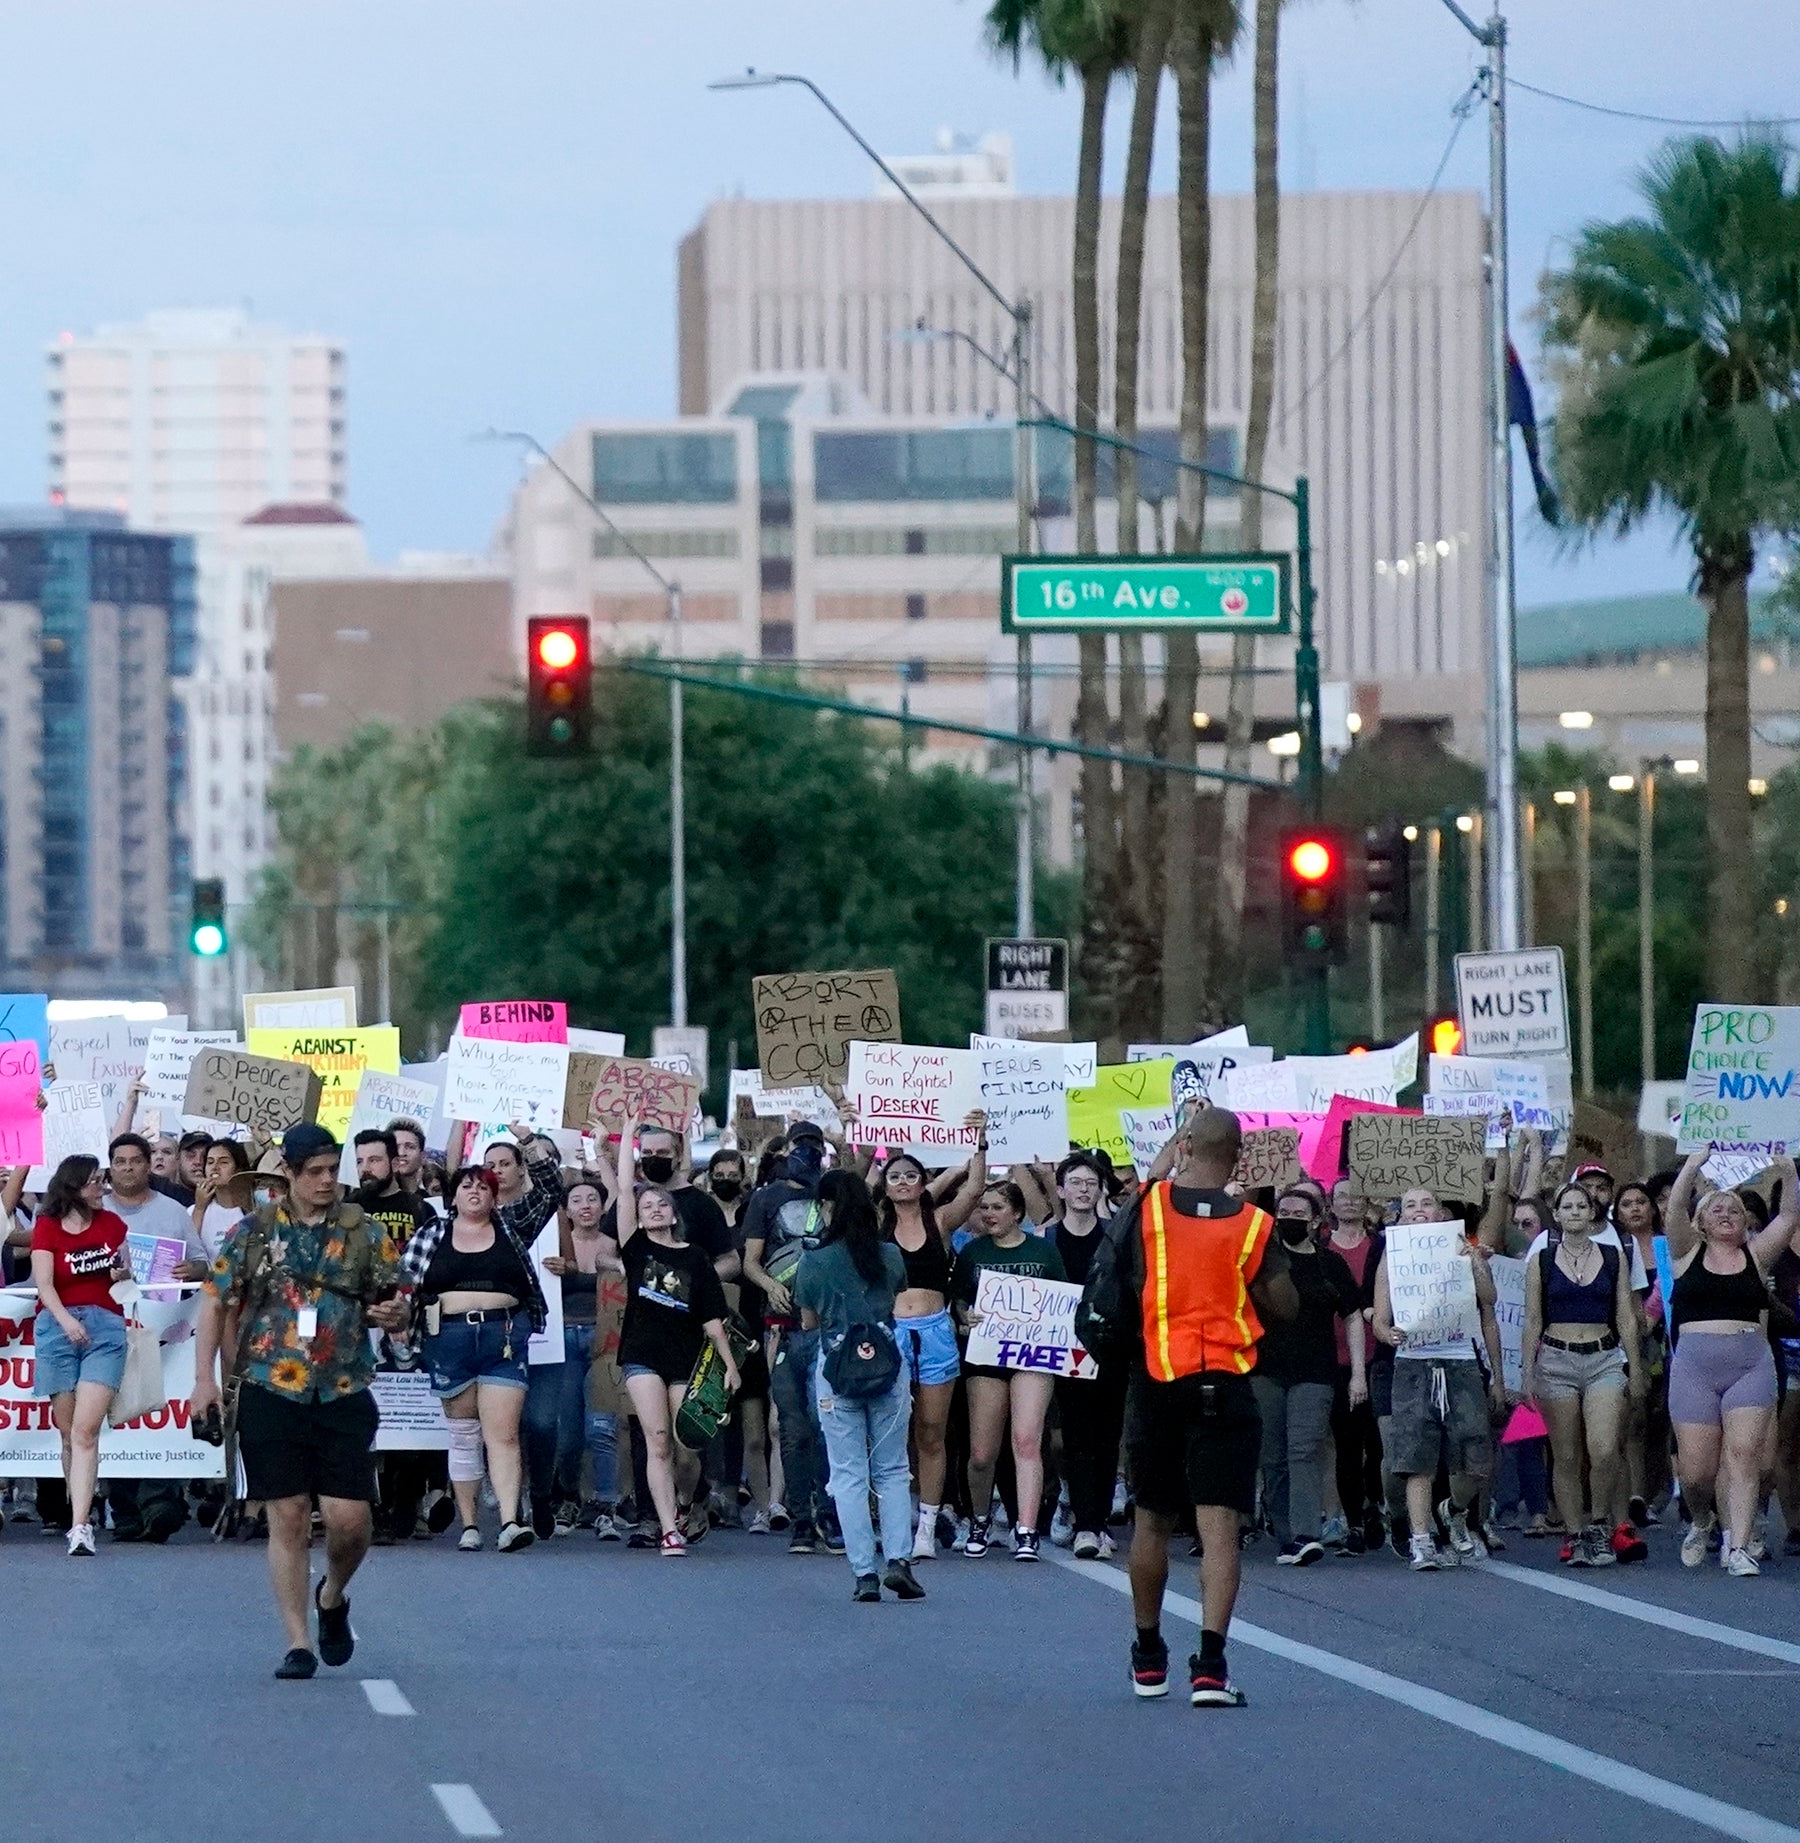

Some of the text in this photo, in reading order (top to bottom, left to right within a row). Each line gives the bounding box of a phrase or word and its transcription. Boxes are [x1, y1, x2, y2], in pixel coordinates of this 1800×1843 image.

[1039, 578, 1191, 609] 16th Ave.
[999, 945, 1053, 967] RIGHT
[1000, 969, 1051, 989] LANE
[1465, 961, 1552, 981] RIGHT LANE
[757, 974, 884, 1005] ABORT
[480, 1002, 555, 1025] BEHIND
[999, 1002, 1054, 1019] BUSES
[1471, 987, 1552, 1019] MUST
[784, 1013, 858, 1039] THE
[1472, 1026, 1559, 1045] TURN RIGHT
[1699, 1010, 1776, 1046] PRO
[48, 1024, 111, 1058] Respect
[170, 1036, 188, 1045] Your
[193, 1036, 232, 1045] Rosaries
[292, 1038, 357, 1055] AGAINST
[457, 1040, 560, 1073] Why does my
[864, 1044, 949, 1074] Fuck your
[982, 1058, 1042, 1077] TERUS
[1691, 1048, 1774, 1072] CHOICE
[364, 1077, 423, 1101] ABORTION
[456, 1073, 488, 1092] have
[601, 1061, 695, 1106] ABORT
[865, 1070, 953, 1098] Gun Rights!
[981, 1080, 1064, 1098] PINION
[1441, 1065, 1484, 1089] REAL
[1717, 1068, 1795, 1101] NOW
[50, 1081, 102, 1113] THE
[231, 1086, 281, 1116] love
[371, 1094, 433, 1119] HEALTHCARE
[491, 1095, 523, 1118] ME
[871, 1095, 940, 1116] DESERVE
[215, 1099, 302, 1132] PUSSY
[1123, 1110, 1174, 1134] Do not
[1683, 1102, 1730, 1125] PRO
[851, 1123, 981, 1146] HUMAN RIGHTS!
[1356, 1117, 1485, 1141] MY HEELS R
[1678, 1125, 1751, 1142] CHOICE
[1355, 1138, 1483, 1162] BIGGER THAN
[1707, 1139, 1787, 1155] ALWAYS
[1350, 1162, 1480, 1193] YOUR DICK
[1388, 1226, 1450, 1256] I hope
[1391, 1254, 1465, 1281] to have as
[990, 1284, 1033, 1315] ALL
[1393, 1278, 1463, 1306] many rights
[1396, 1310, 1412, 1324] as
[1416, 1309, 1430, 1322] a
[977, 1312, 1069, 1347] deserve to
[396, 1375, 411, 1384] Lou
[99, 1448, 163, 1463] productive
[165, 1449, 206, 1462] Justice
